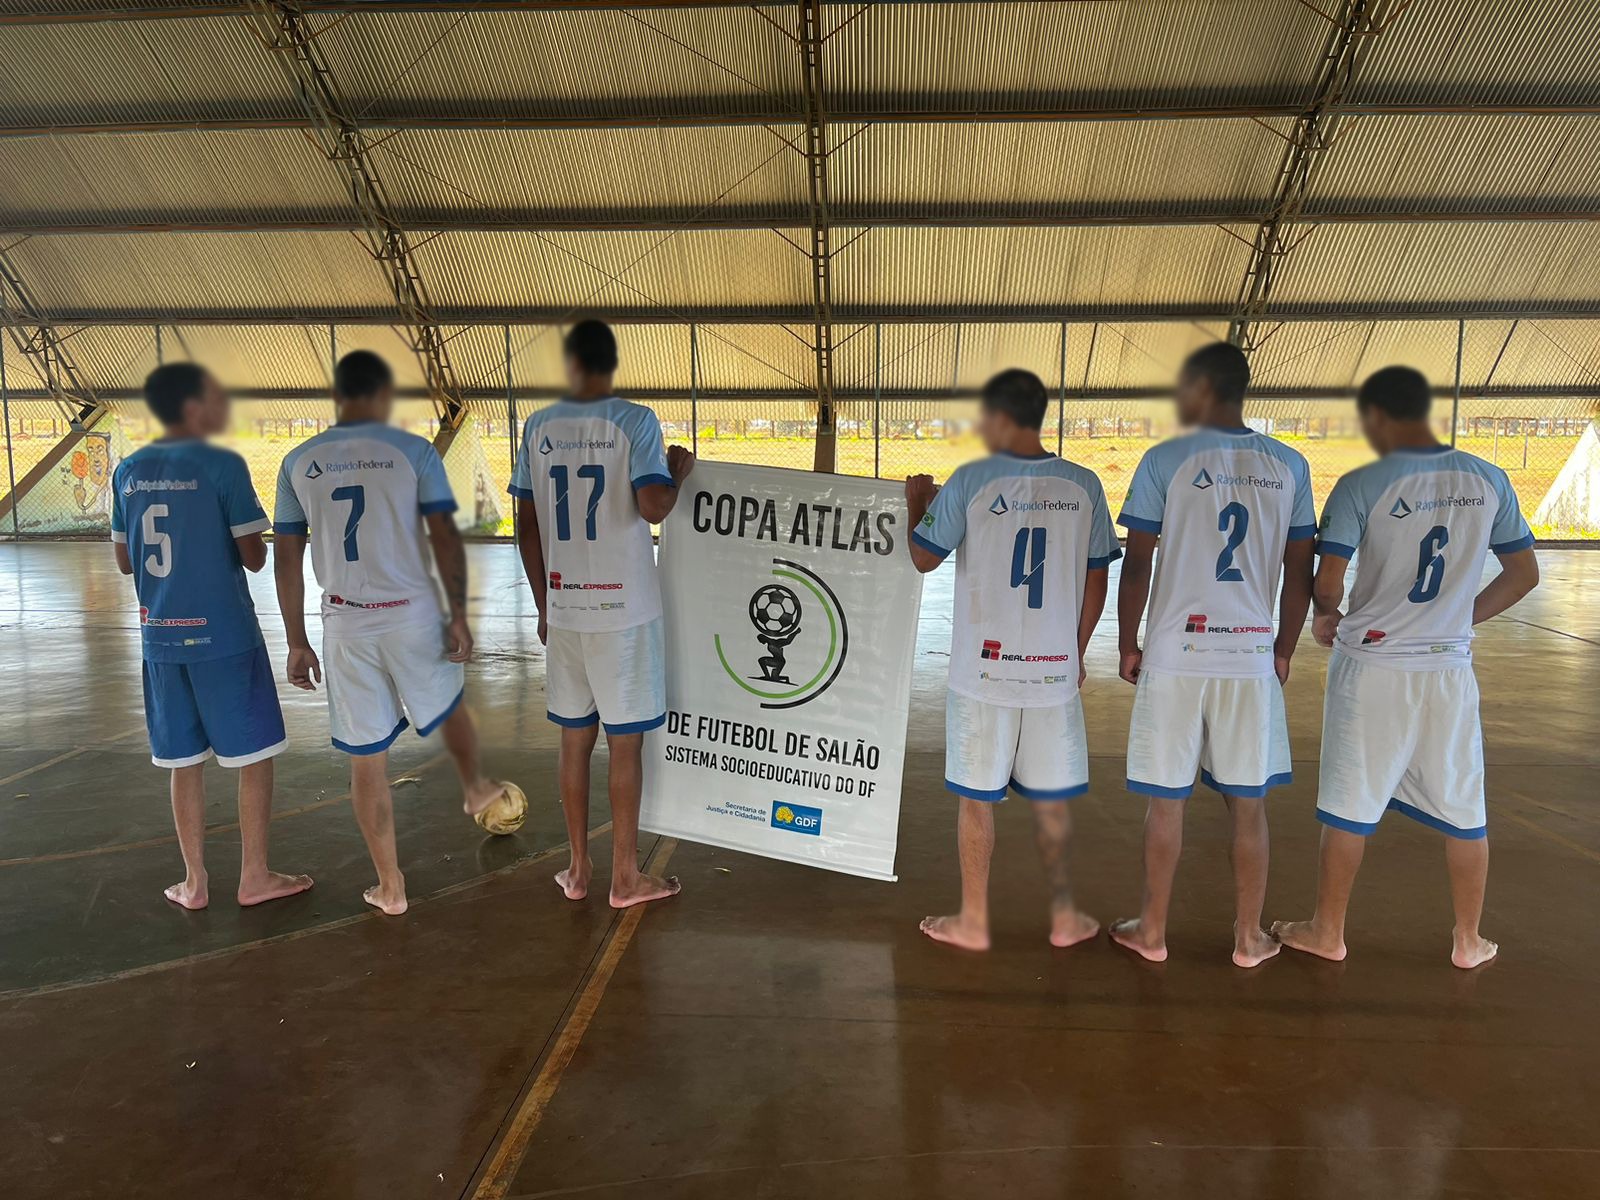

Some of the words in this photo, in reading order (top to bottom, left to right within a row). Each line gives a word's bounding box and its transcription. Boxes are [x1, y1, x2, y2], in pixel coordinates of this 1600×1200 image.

[326, 460, 393, 473] RápidoFederal
[331, 485, 365, 562] 7
[549, 464, 605, 541] 17
[692, 490, 777, 542] COPA
[789, 502, 896, 556] ATLAS
[1011, 500, 1080, 512] RápidoFederal
[141, 503, 172, 578] 5
[1010, 527, 1047, 609] 4
[1216, 501, 1249, 581] 2
[1407, 525, 1449, 604] 6
[345, 599, 410, 609] REALEXPRESSO
[1002, 654, 1069, 662] REALEXPRESSO
[667, 710, 691, 737] DE
[697, 716, 777, 754] FUTEBOL
[785, 731, 811, 759] DE
[815, 736, 880, 771] SALÃO
[665, 745, 718, 771] SISTEMA
[720, 754, 831, 791] SOCIOEDUCATIVO
[834, 775, 854, 795] DO
[858, 779, 876, 799] DF
[706, 805, 728, 815] Justiça
[734, 810, 766, 822] Cidadania
[725, 801, 757, 814] Secretaria
[794, 816, 818, 828] GDF
